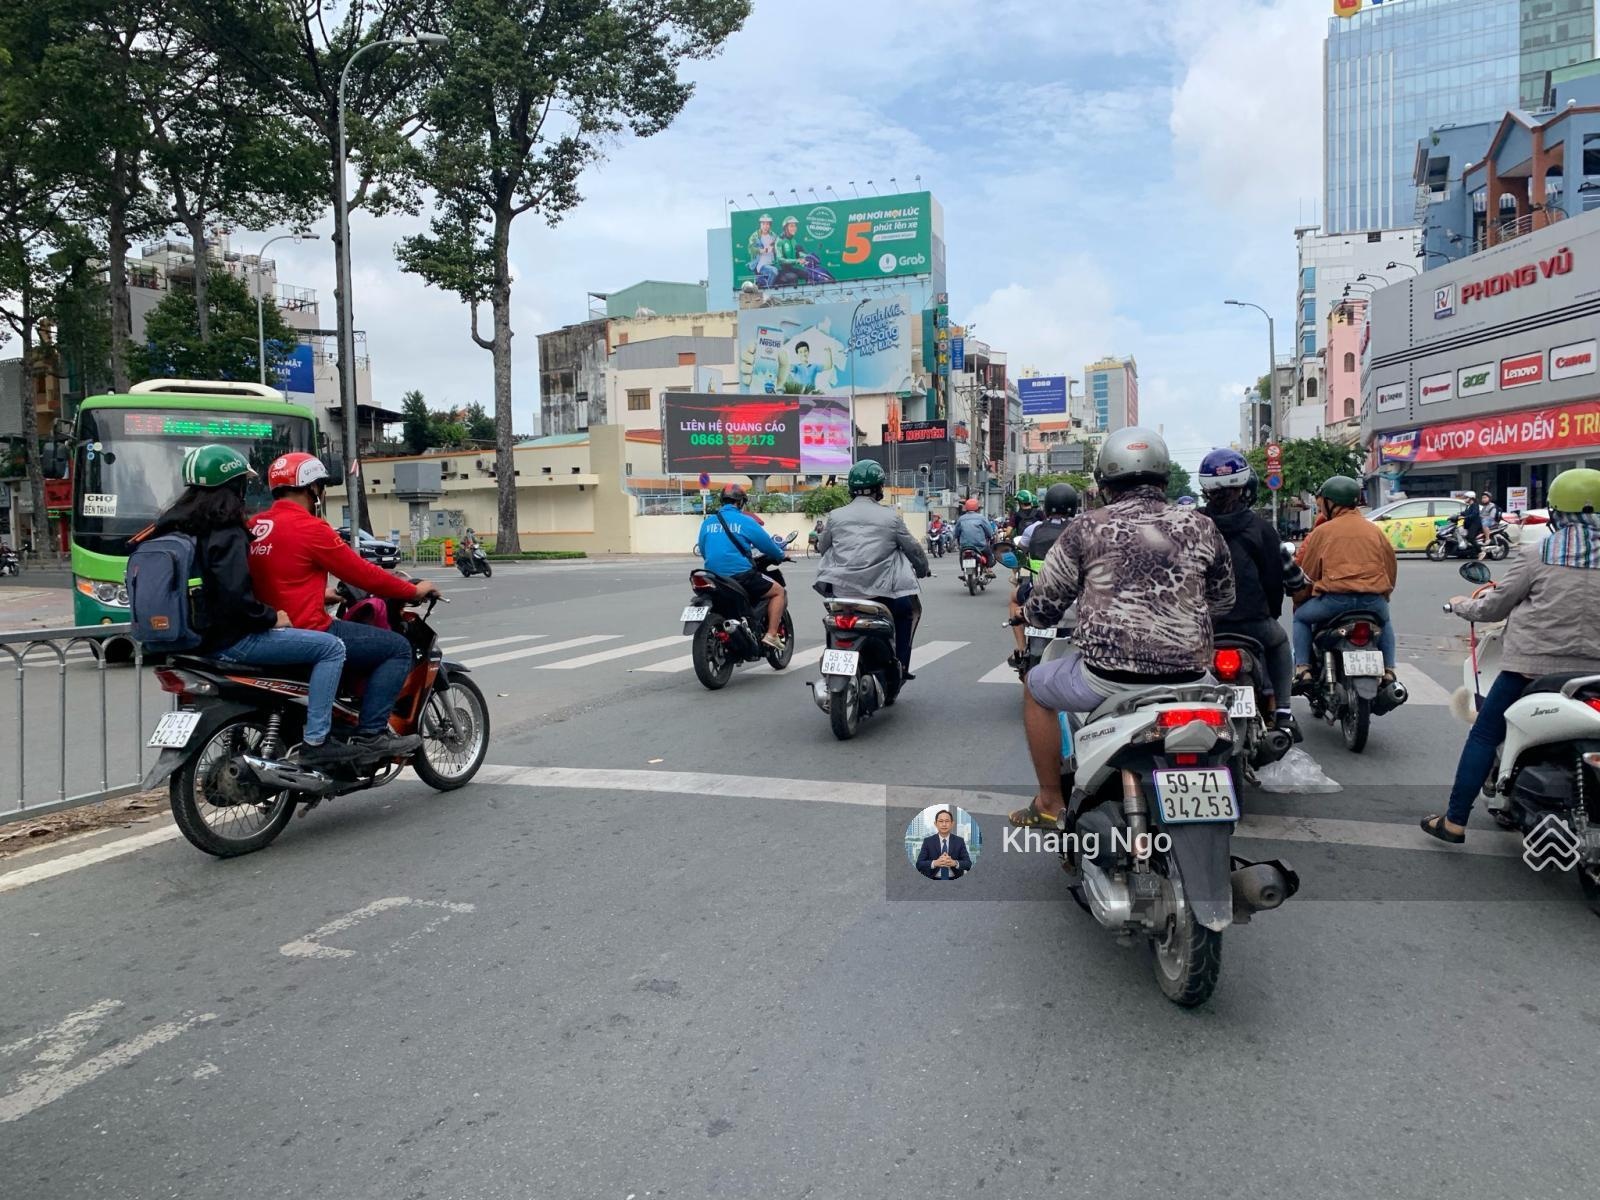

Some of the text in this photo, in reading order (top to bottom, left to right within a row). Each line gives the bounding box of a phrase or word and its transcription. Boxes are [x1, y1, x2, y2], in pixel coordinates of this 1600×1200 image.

[848, 213, 865, 223] MỌI
[866, 211, 883, 220] NƠI
[902, 207, 919, 217] LÚC
[873, 221, 918, 233] phút lên xe
[842, 222, 872, 264] 5
[899, 253, 926, 266] Grab
[1461, 264, 1537, 304] PHONG
[1539, 247, 1574, 278] VŨ
[1555, 353, 1592, 368] Canon
[1463, 372, 1490, 388] acer
[1504, 365, 1538, 380] Lenovo
[680, 419, 706, 431] LIÊN
[709, 420, 722, 433] HỆ
[764, 420, 786, 433] CÁO
[1426, 429, 1475, 452] LAPTOP
[1479, 421, 1517, 446] GIẢM
[1521, 412, 1555, 441] ĐẾN
[1558, 413, 1570, 437] 3
[1574, 412, 1600, 435] TRI
[691, 433, 775, 446] 0868 524178
[220, 458, 241, 473] Grab
[706, 523, 741, 534] VIETAM
[1530, 707, 1560, 717] Janus
[1166, 772, 1219, 794] 59-Z1
[1164, 796, 1233, 818] 342.53
